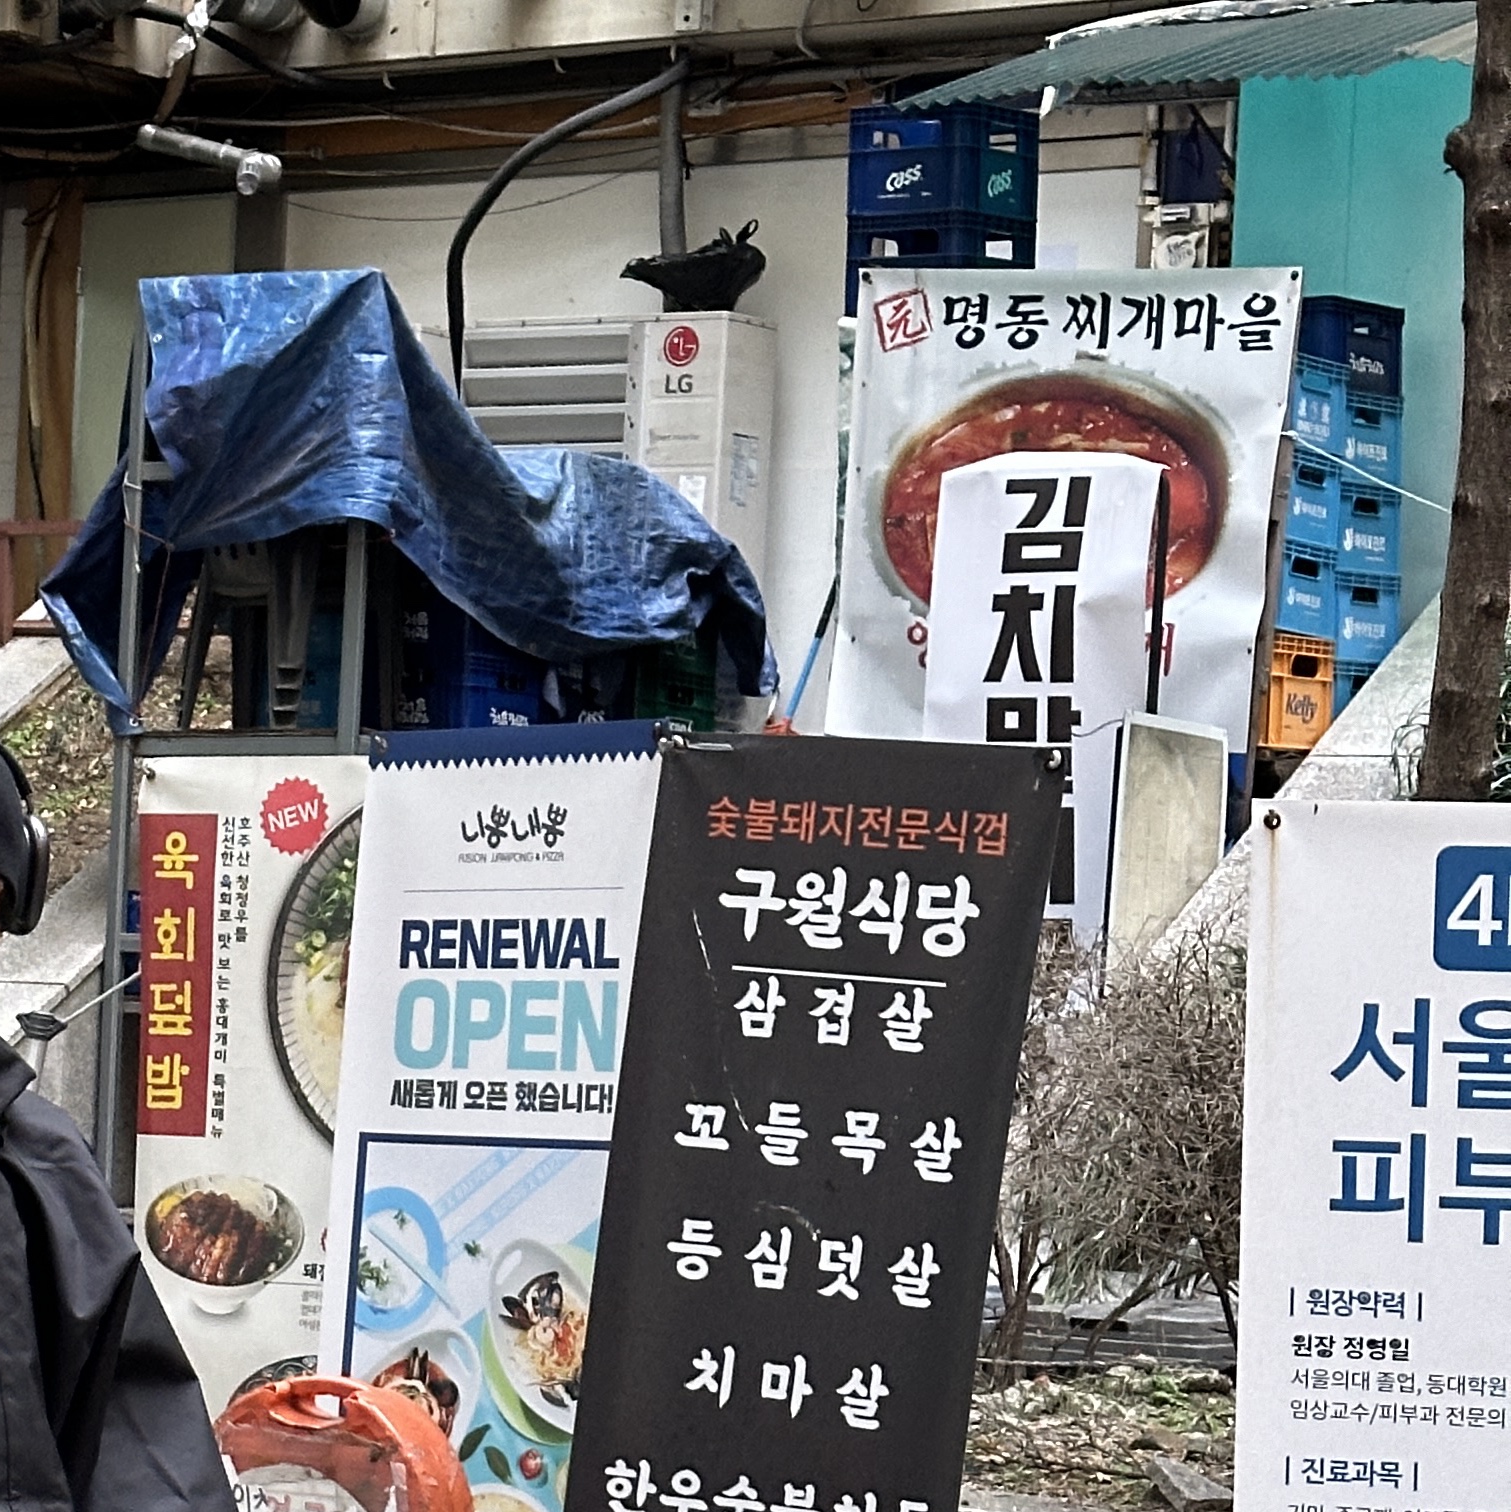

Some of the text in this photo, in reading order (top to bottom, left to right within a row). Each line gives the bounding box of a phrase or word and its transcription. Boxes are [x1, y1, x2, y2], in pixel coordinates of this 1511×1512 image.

[942, 291, 1282, 353] 명동 찌개마을
[664, 373, 693, 394] LG
[1285, 692, 1318, 724] Kelly
[267, 798, 320, 833] NEW
[220, 816, 236, 868] 신선한
[236, 816, 253, 868] 호주산
[718, 865, 981, 959] 구월식당
[1446, 873, 1511, 947] 4
[399, 917, 620, 970] RENEWAL
[146, 831, 200, 1110] 육회덮밥
[393, 978, 620, 1073] OPEN
[733, 974, 934, 1054] 삼겹살
[390, 1079, 614, 1114] 새롭게 오픈 했습니다!
[673, 1102, 963, 1184] 꼬들목살
[666, 1217, 942, 1309] 등심덧살
[1305, 1288, 1406, 1320] 원장약력
[1291, 1334, 1337, 1359] 원장
[684, 1345, 890, 1431] 치마살
[1290, 1367, 1371, 1392] 서울의대
[1376, 1371, 1422, 1396] 졸업,
[1289, 1398, 1507, 1430] 임상교수/피부과 전문의
[1300, 1457, 1403, 1491] 진료과목
